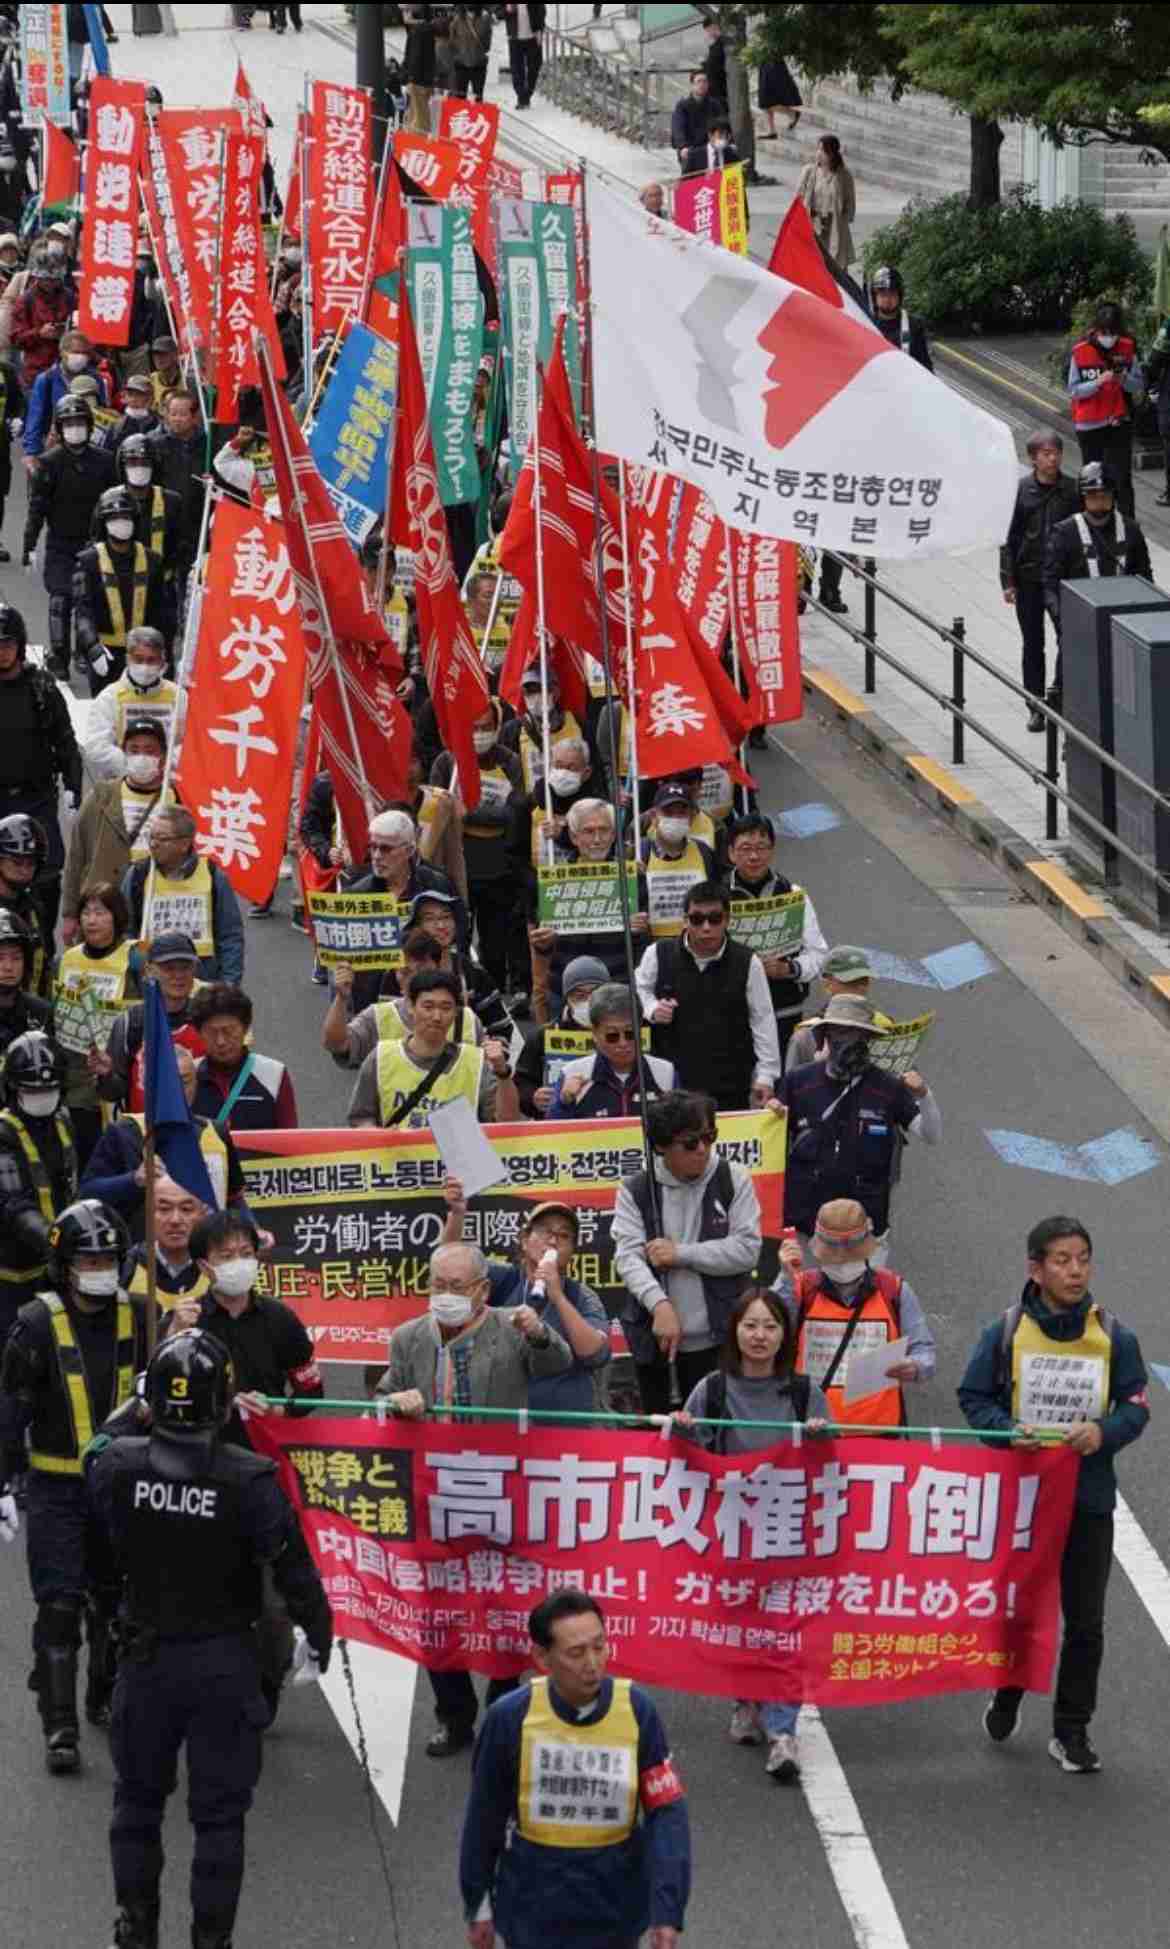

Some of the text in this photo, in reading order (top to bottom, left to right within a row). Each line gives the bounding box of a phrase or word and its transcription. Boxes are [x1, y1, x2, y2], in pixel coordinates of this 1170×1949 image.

[194, 526, 297, 872] 動労千葉
[171, 1377, 188, 1397] 3
[134, 1481, 217, 1518] POLICE
[425, 1449, 1040, 1562] 高市政権打倒！
[674, 1571, 1017, 1621] ガザ虐殺を止めろ！
